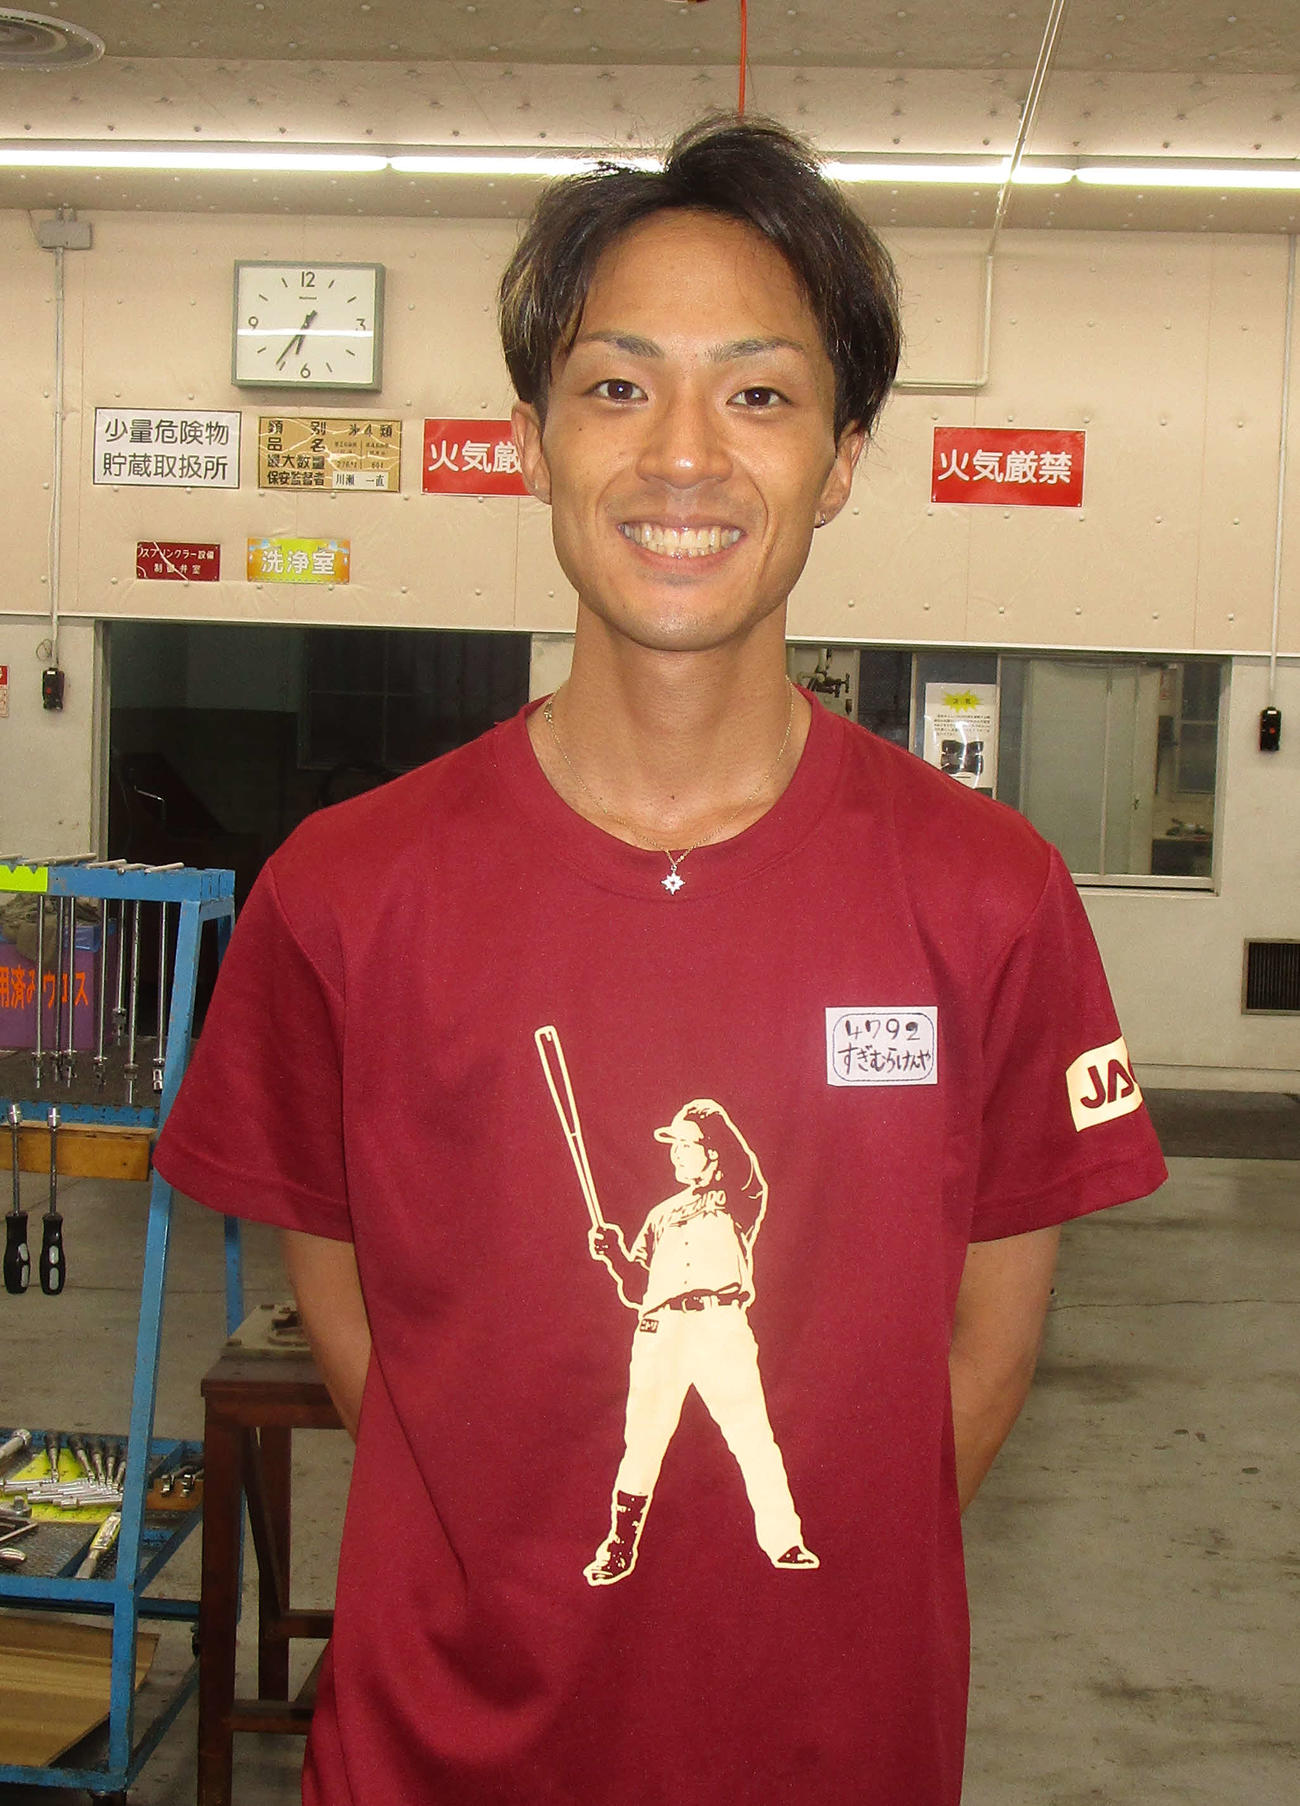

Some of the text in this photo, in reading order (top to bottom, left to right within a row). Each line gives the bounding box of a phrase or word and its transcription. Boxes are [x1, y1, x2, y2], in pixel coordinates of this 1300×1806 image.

[301, 271, 315, 288] 12
[248, 316, 259, 330] 9
[355, 318, 366, 331] 3
[300, 363, 311, 379] 6
[105, 418, 229, 446] 少量危険物
[103, 452, 229, 480] 貯蔵取扱所
[267, 470, 325, 486] 保安監督者
[937, 448, 1073, 485] 火気厳禁
[261, 550, 335, 575] 洗浄室
[845, 1018, 921, 1041] 4792
[837, 1042, 932, 1075] すぎむらけんや
[1079, 1056, 1137, 1109] JA
